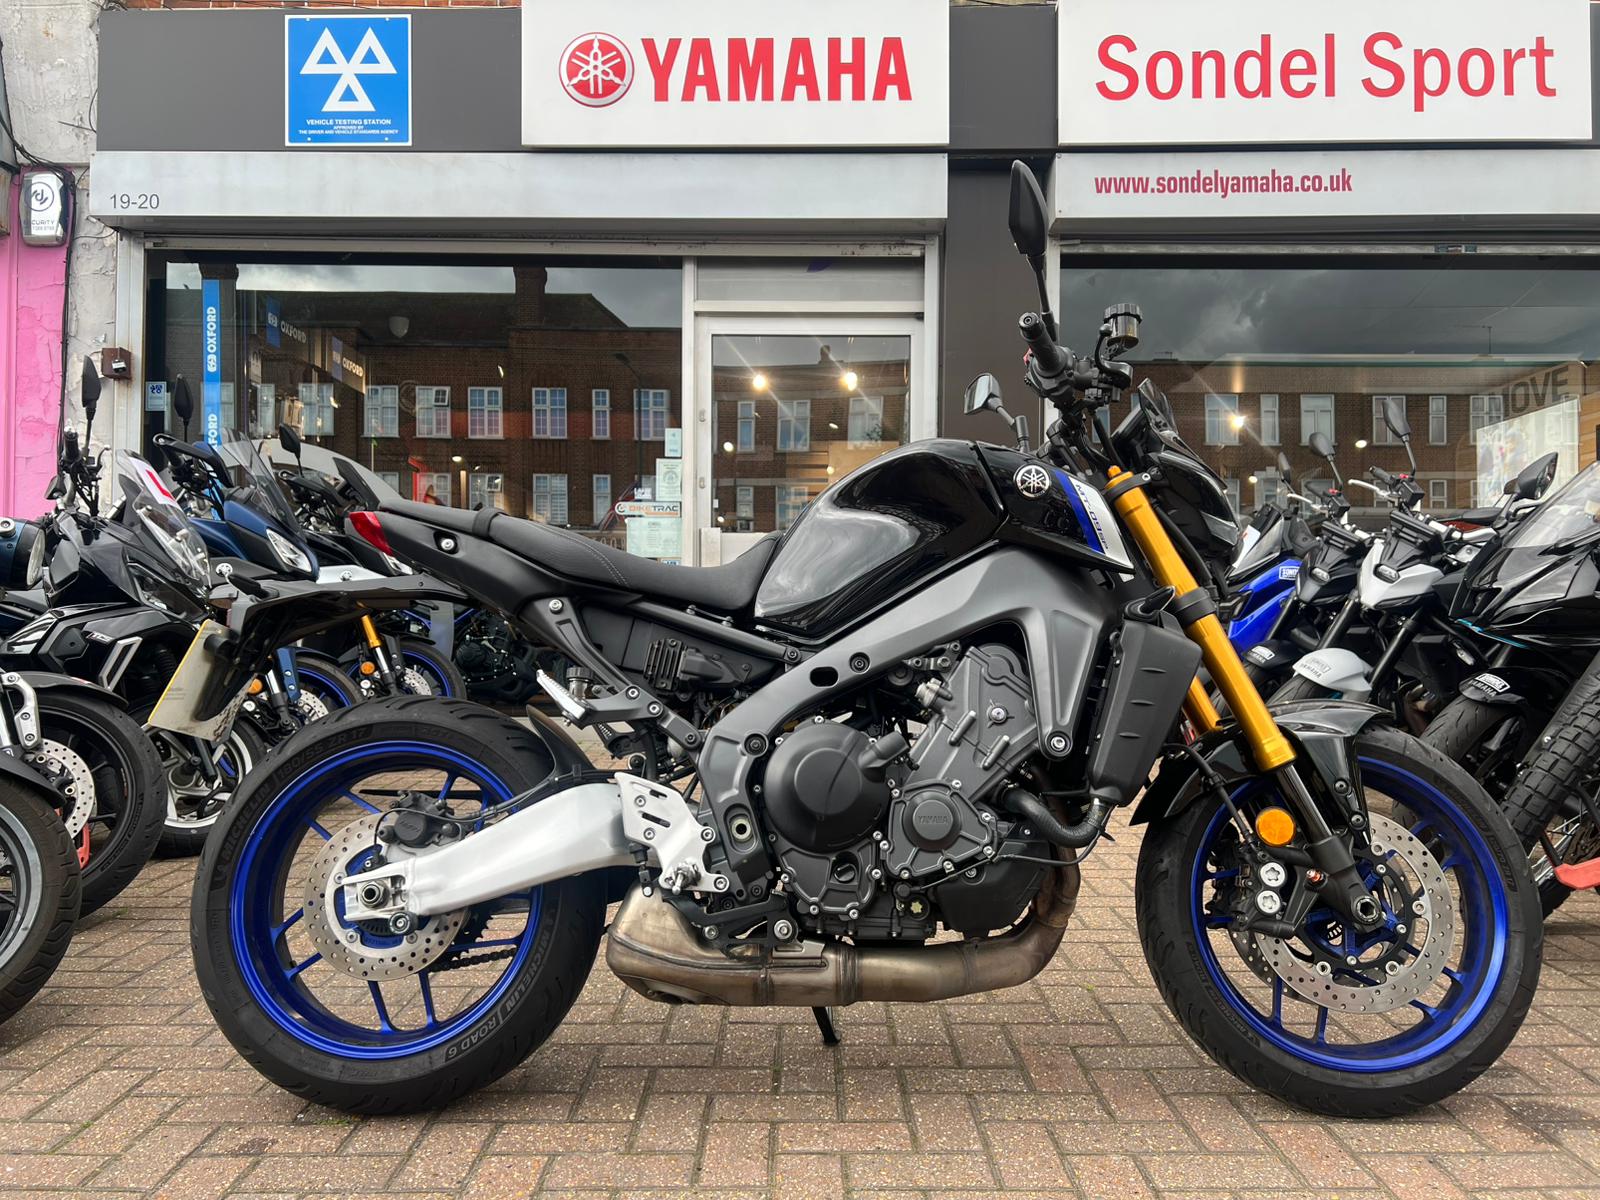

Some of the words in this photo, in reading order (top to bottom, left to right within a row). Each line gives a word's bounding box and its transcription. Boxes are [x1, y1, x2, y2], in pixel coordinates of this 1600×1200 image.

[641, 38, 912, 102] YAMAHA
[1096, 34, 1336, 101] Sondel
[1362, 32, 1558, 112] Sport
[1094, 168, 1352, 198] www.sondelyamaha.co.uk
[110, 193, 160, 210] 19-20
[207, 307, 217, 353] OXFORD
[281, 320, 307, 343] OXFORD
[342, 357, 364, 377] OXFORD
[208, 413, 218, 450] FORD
[222, 782, 274, 865] MICHELIN
[918, 815, 948, 825] YAMAHA
[504, 930, 551, 1012] MICHELIN
[461, 1016, 497, 1051] ROAD
